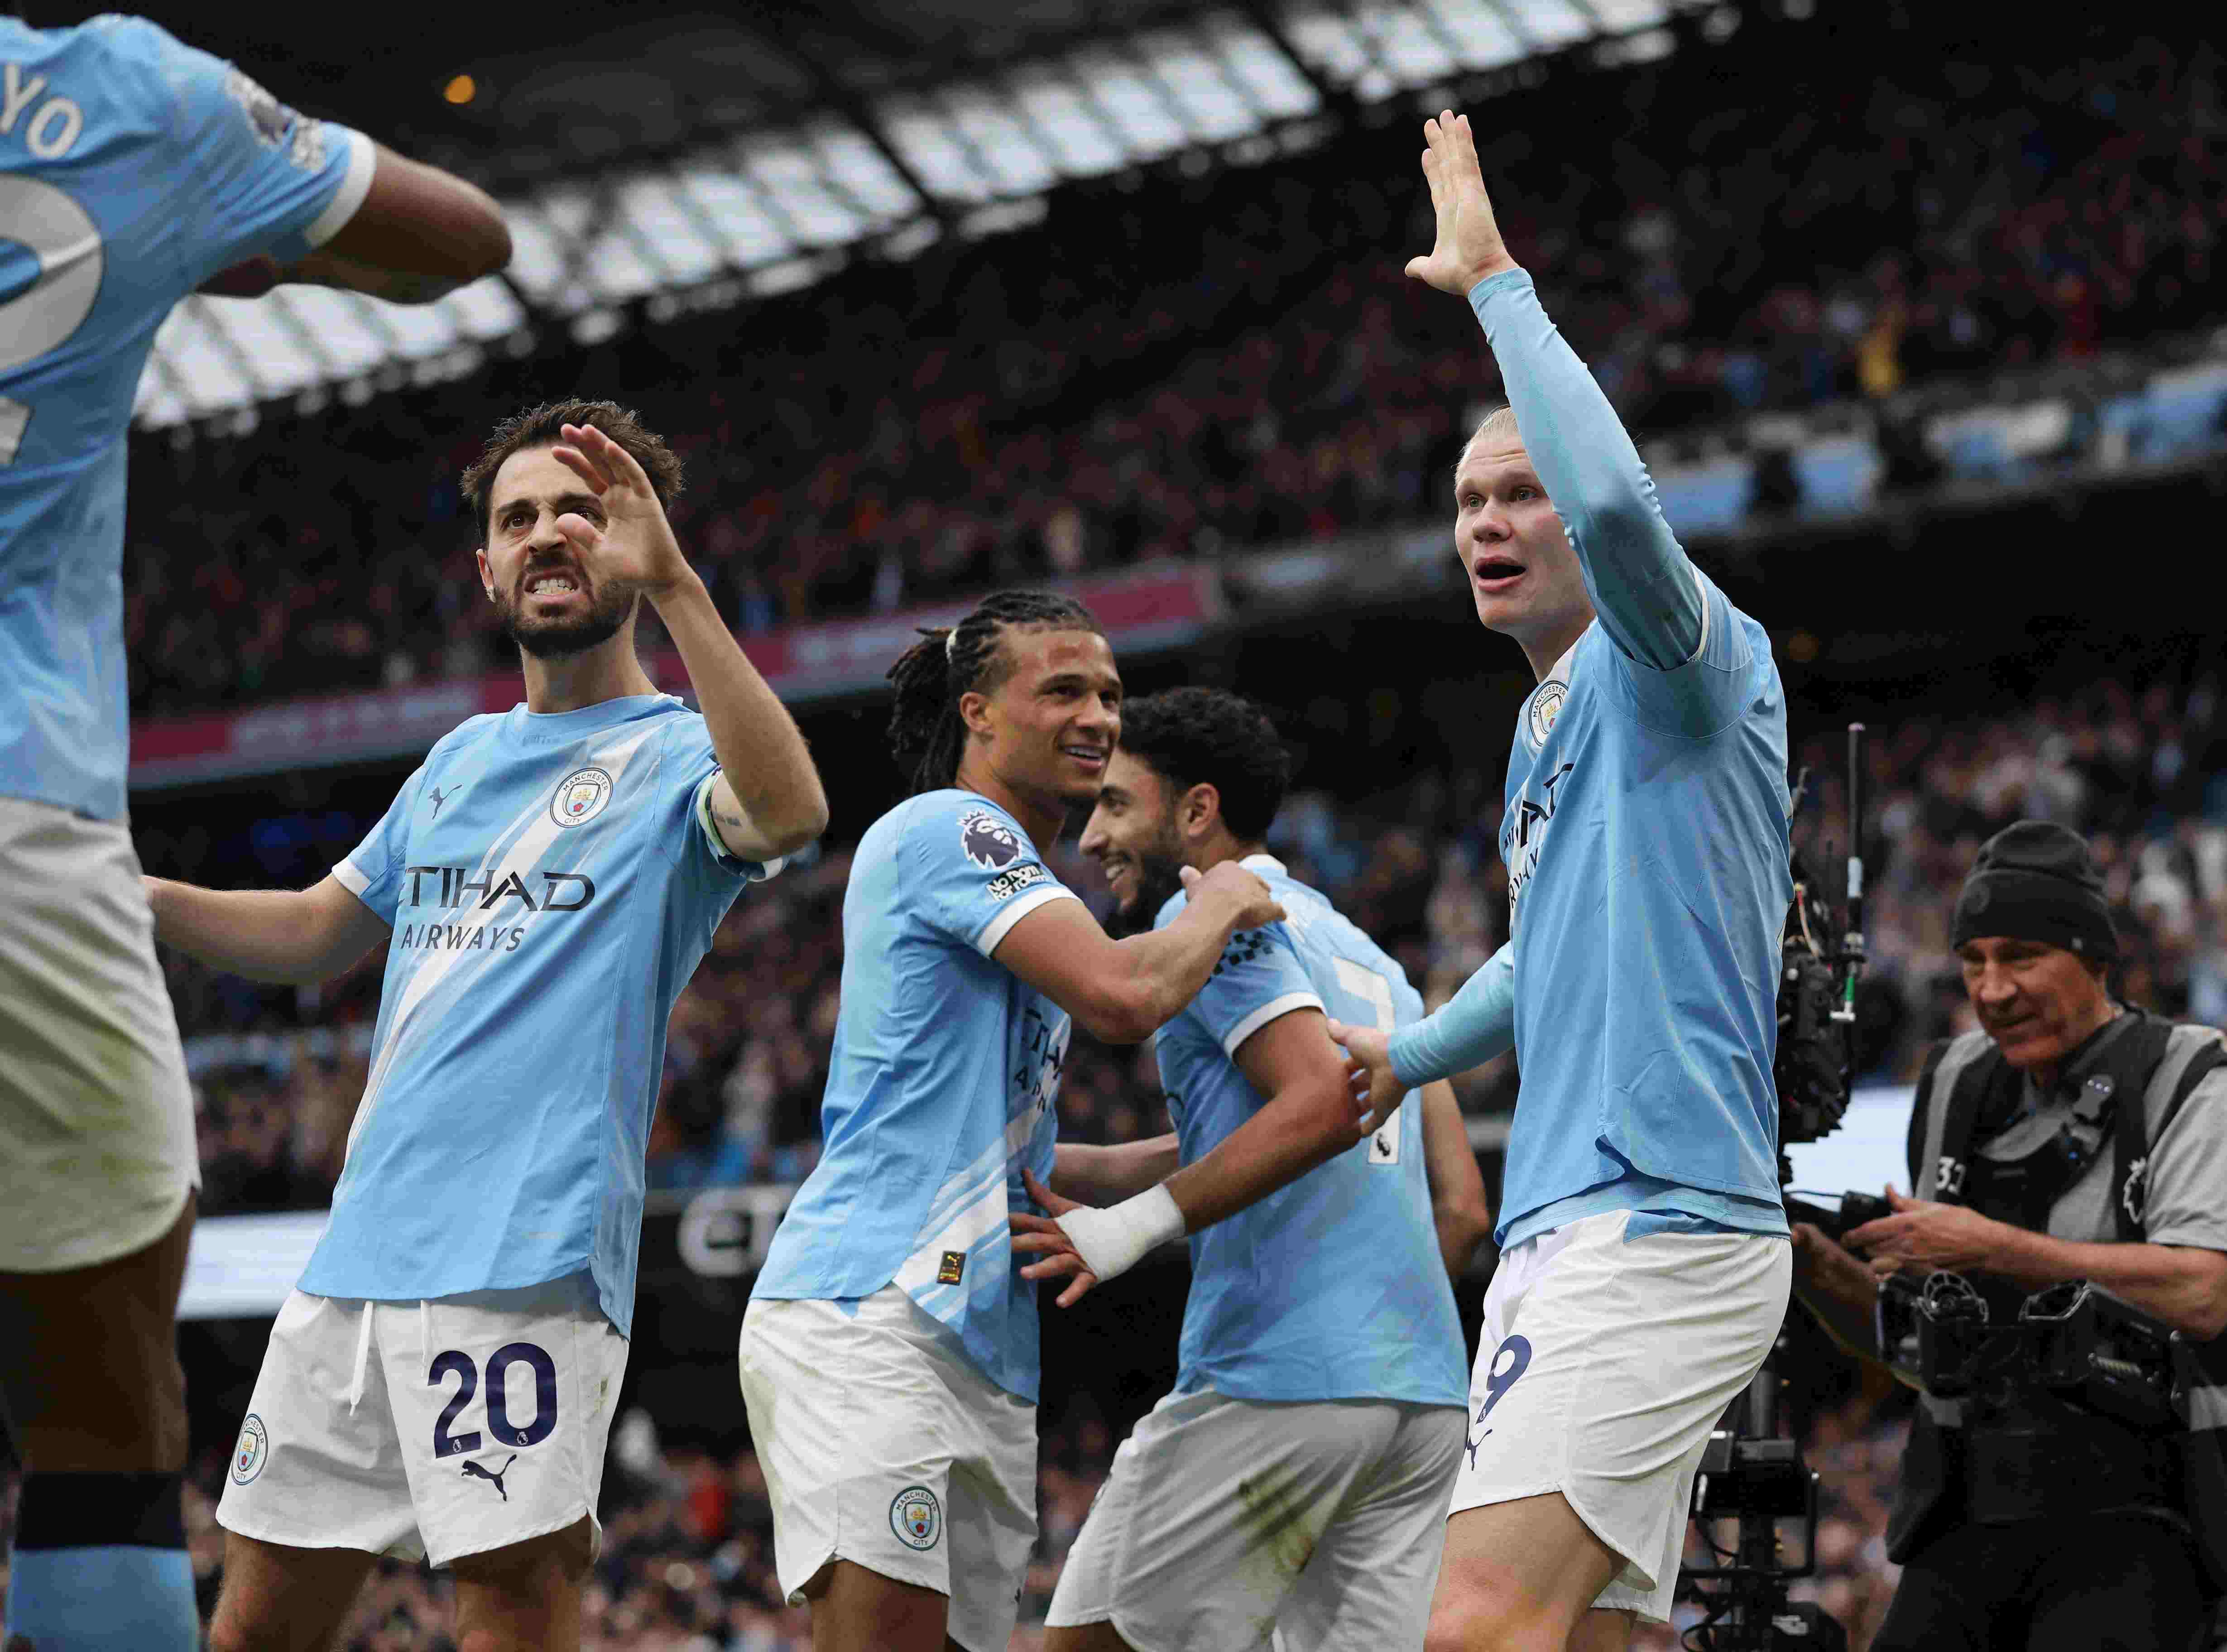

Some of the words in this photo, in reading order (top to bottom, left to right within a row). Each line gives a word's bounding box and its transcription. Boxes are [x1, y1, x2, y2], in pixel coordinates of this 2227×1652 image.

[1532, 686, 1566, 717] MANCHESTER
[562, 772, 609, 792] MANCHESTER
[398, 865, 595, 912] TIHAD
[985, 877, 1009, 891] No
[1006, 865, 1040, 882] room
[400, 923, 525, 951] AIRWAYS
[1475, 1334, 1532, 1425] 9
[427, 1342, 557, 1459] 20
[896, 1492, 936, 1511] MANCHESTER
